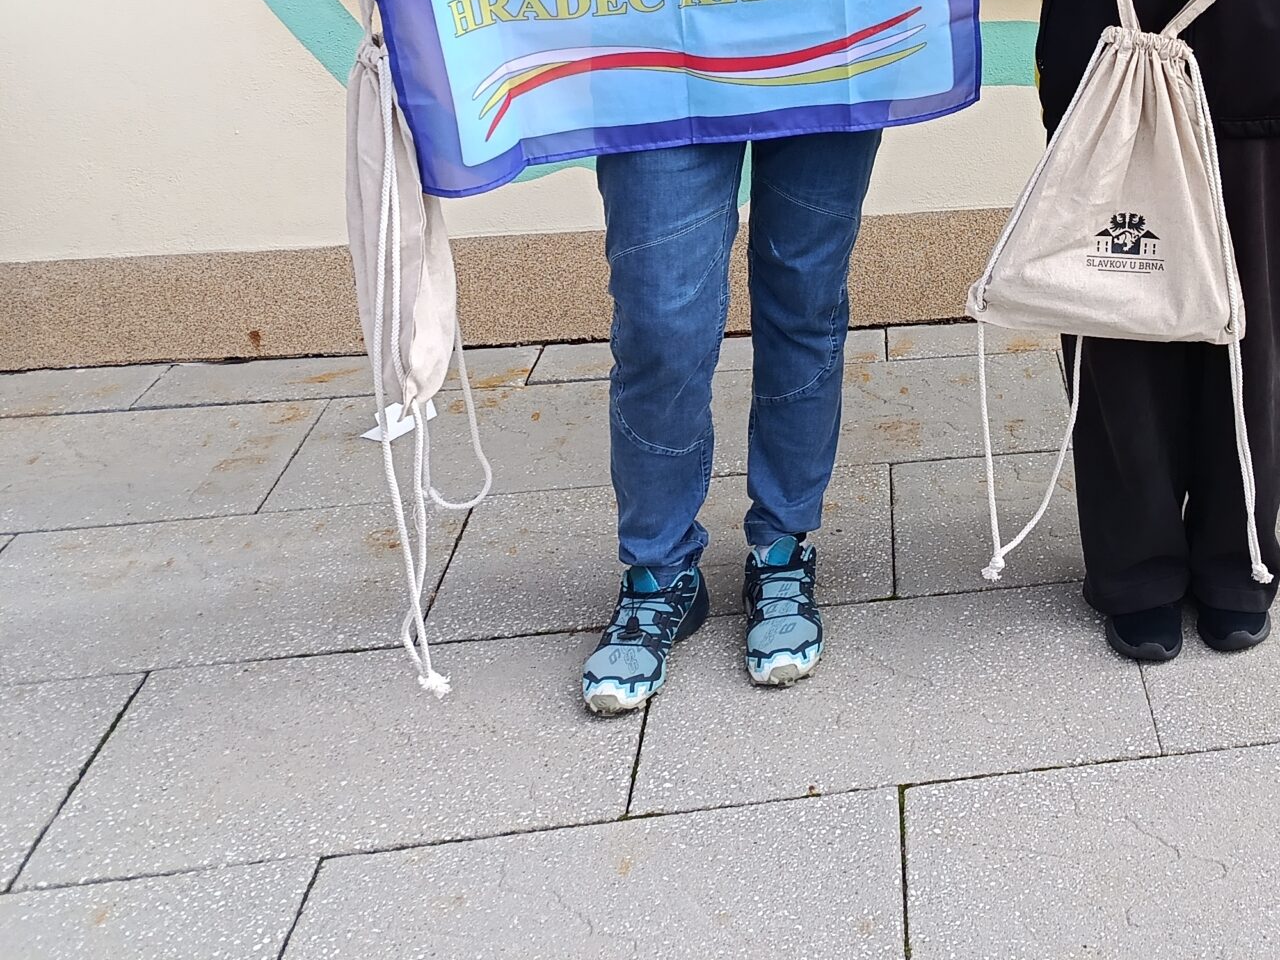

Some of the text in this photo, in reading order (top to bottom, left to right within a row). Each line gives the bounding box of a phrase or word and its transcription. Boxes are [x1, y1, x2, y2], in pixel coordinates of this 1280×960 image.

[1086, 258, 1165, 271] SLAVKOV U BRNA
